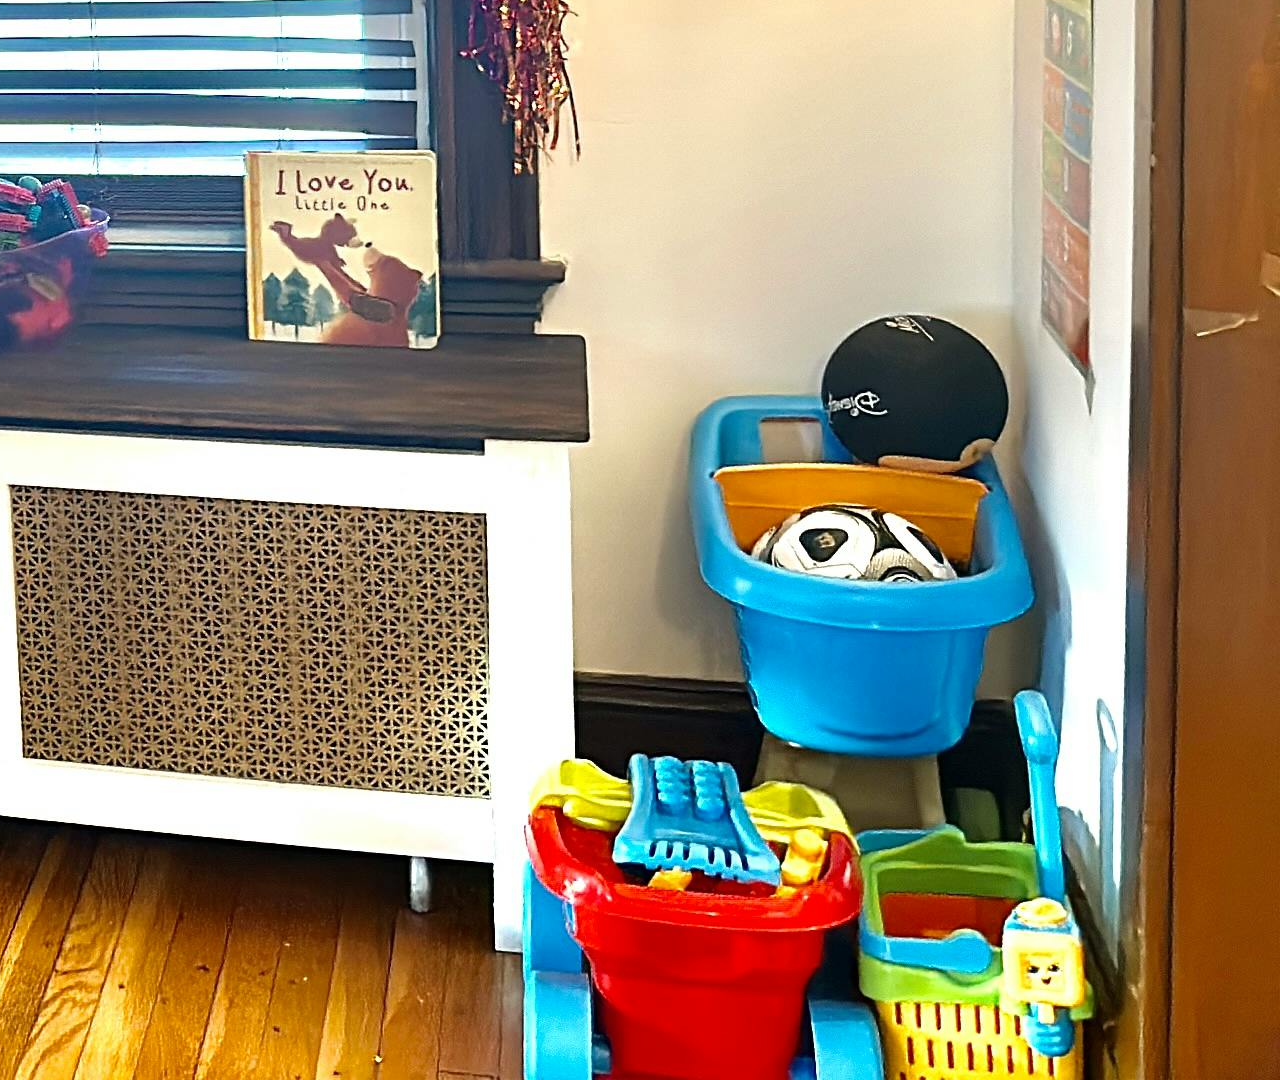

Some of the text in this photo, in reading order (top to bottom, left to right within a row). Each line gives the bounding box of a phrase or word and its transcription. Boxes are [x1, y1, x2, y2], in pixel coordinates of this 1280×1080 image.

[275, 170, 287, 195] I
[296, 170, 354, 194] Love
[295, 195, 390, 211] Little One
